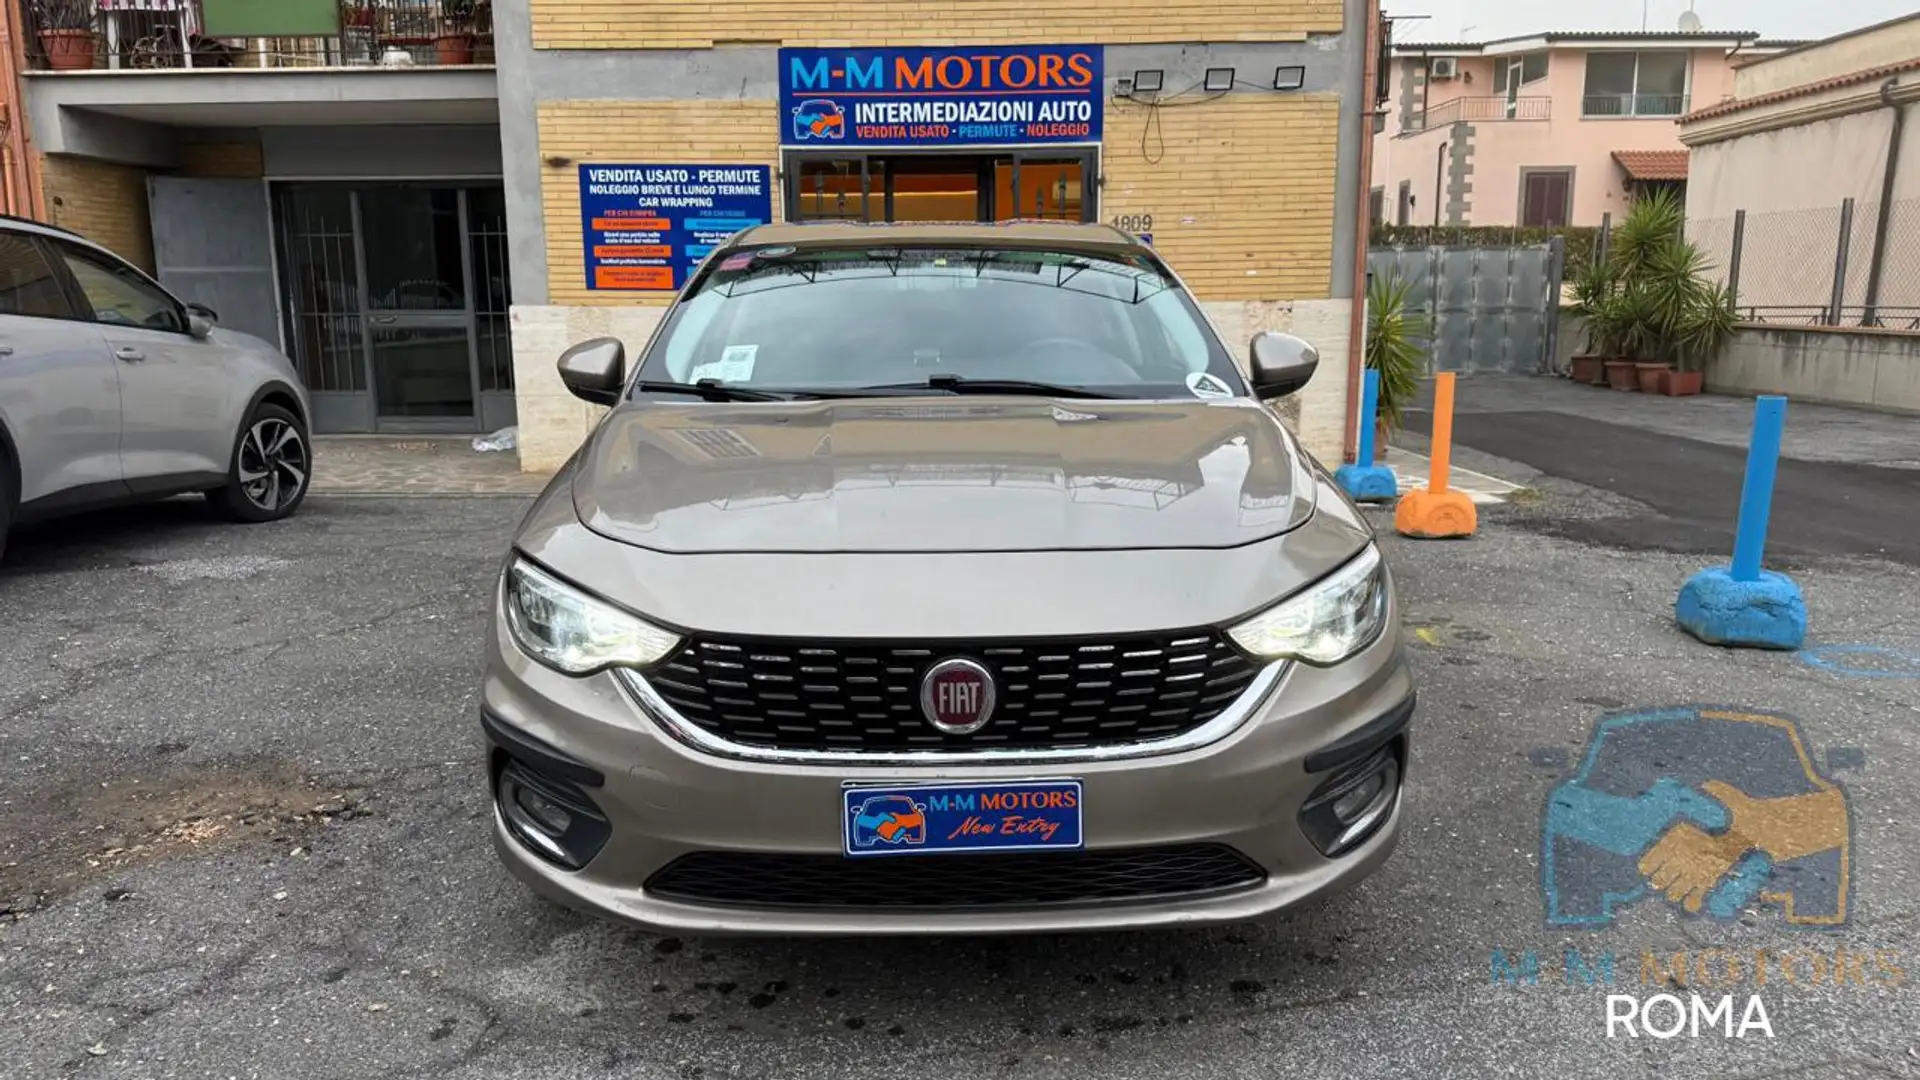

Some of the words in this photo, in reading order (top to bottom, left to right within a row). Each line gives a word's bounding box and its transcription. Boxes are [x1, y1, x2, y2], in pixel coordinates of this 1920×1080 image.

[791, 56, 884, 89] M-M
[895, 53, 1093, 89] MOTORS
[855, 101, 1033, 123] INTERMEDIAZIONI
[1038, 100, 1091, 121] AUTO
[856, 126, 907, 139] VENDITA
[910, 126, 949, 138] USATO
[958, 125, 1017, 137] PERMUTE
[1026, 123, 1089, 137] NOLEGGIO
[589, 169, 643, 183] VENDITA
[646, 169, 688, 183] USATO
[700, 169, 761, 183] PERMUTE
[589, 184, 639, 195] NOLEGGIO
[641, 184, 673, 195] BREVE
[675, 184, 681, 195] E
[682, 184, 716, 195] LUNGO
[718, 184, 761, 195] TERMINE
[638, 197, 659, 207] CAR
[660, 197, 713, 208] WRAPPING
[1111, 214, 1153, 232] 1809
[938, 682, 981, 714] FIAT
[929, 793, 976, 812] M-M
[980, 791, 1077, 810] MOTORS
[948, 815, 995, 840] New
[999, 816, 1061, 841] Entry
